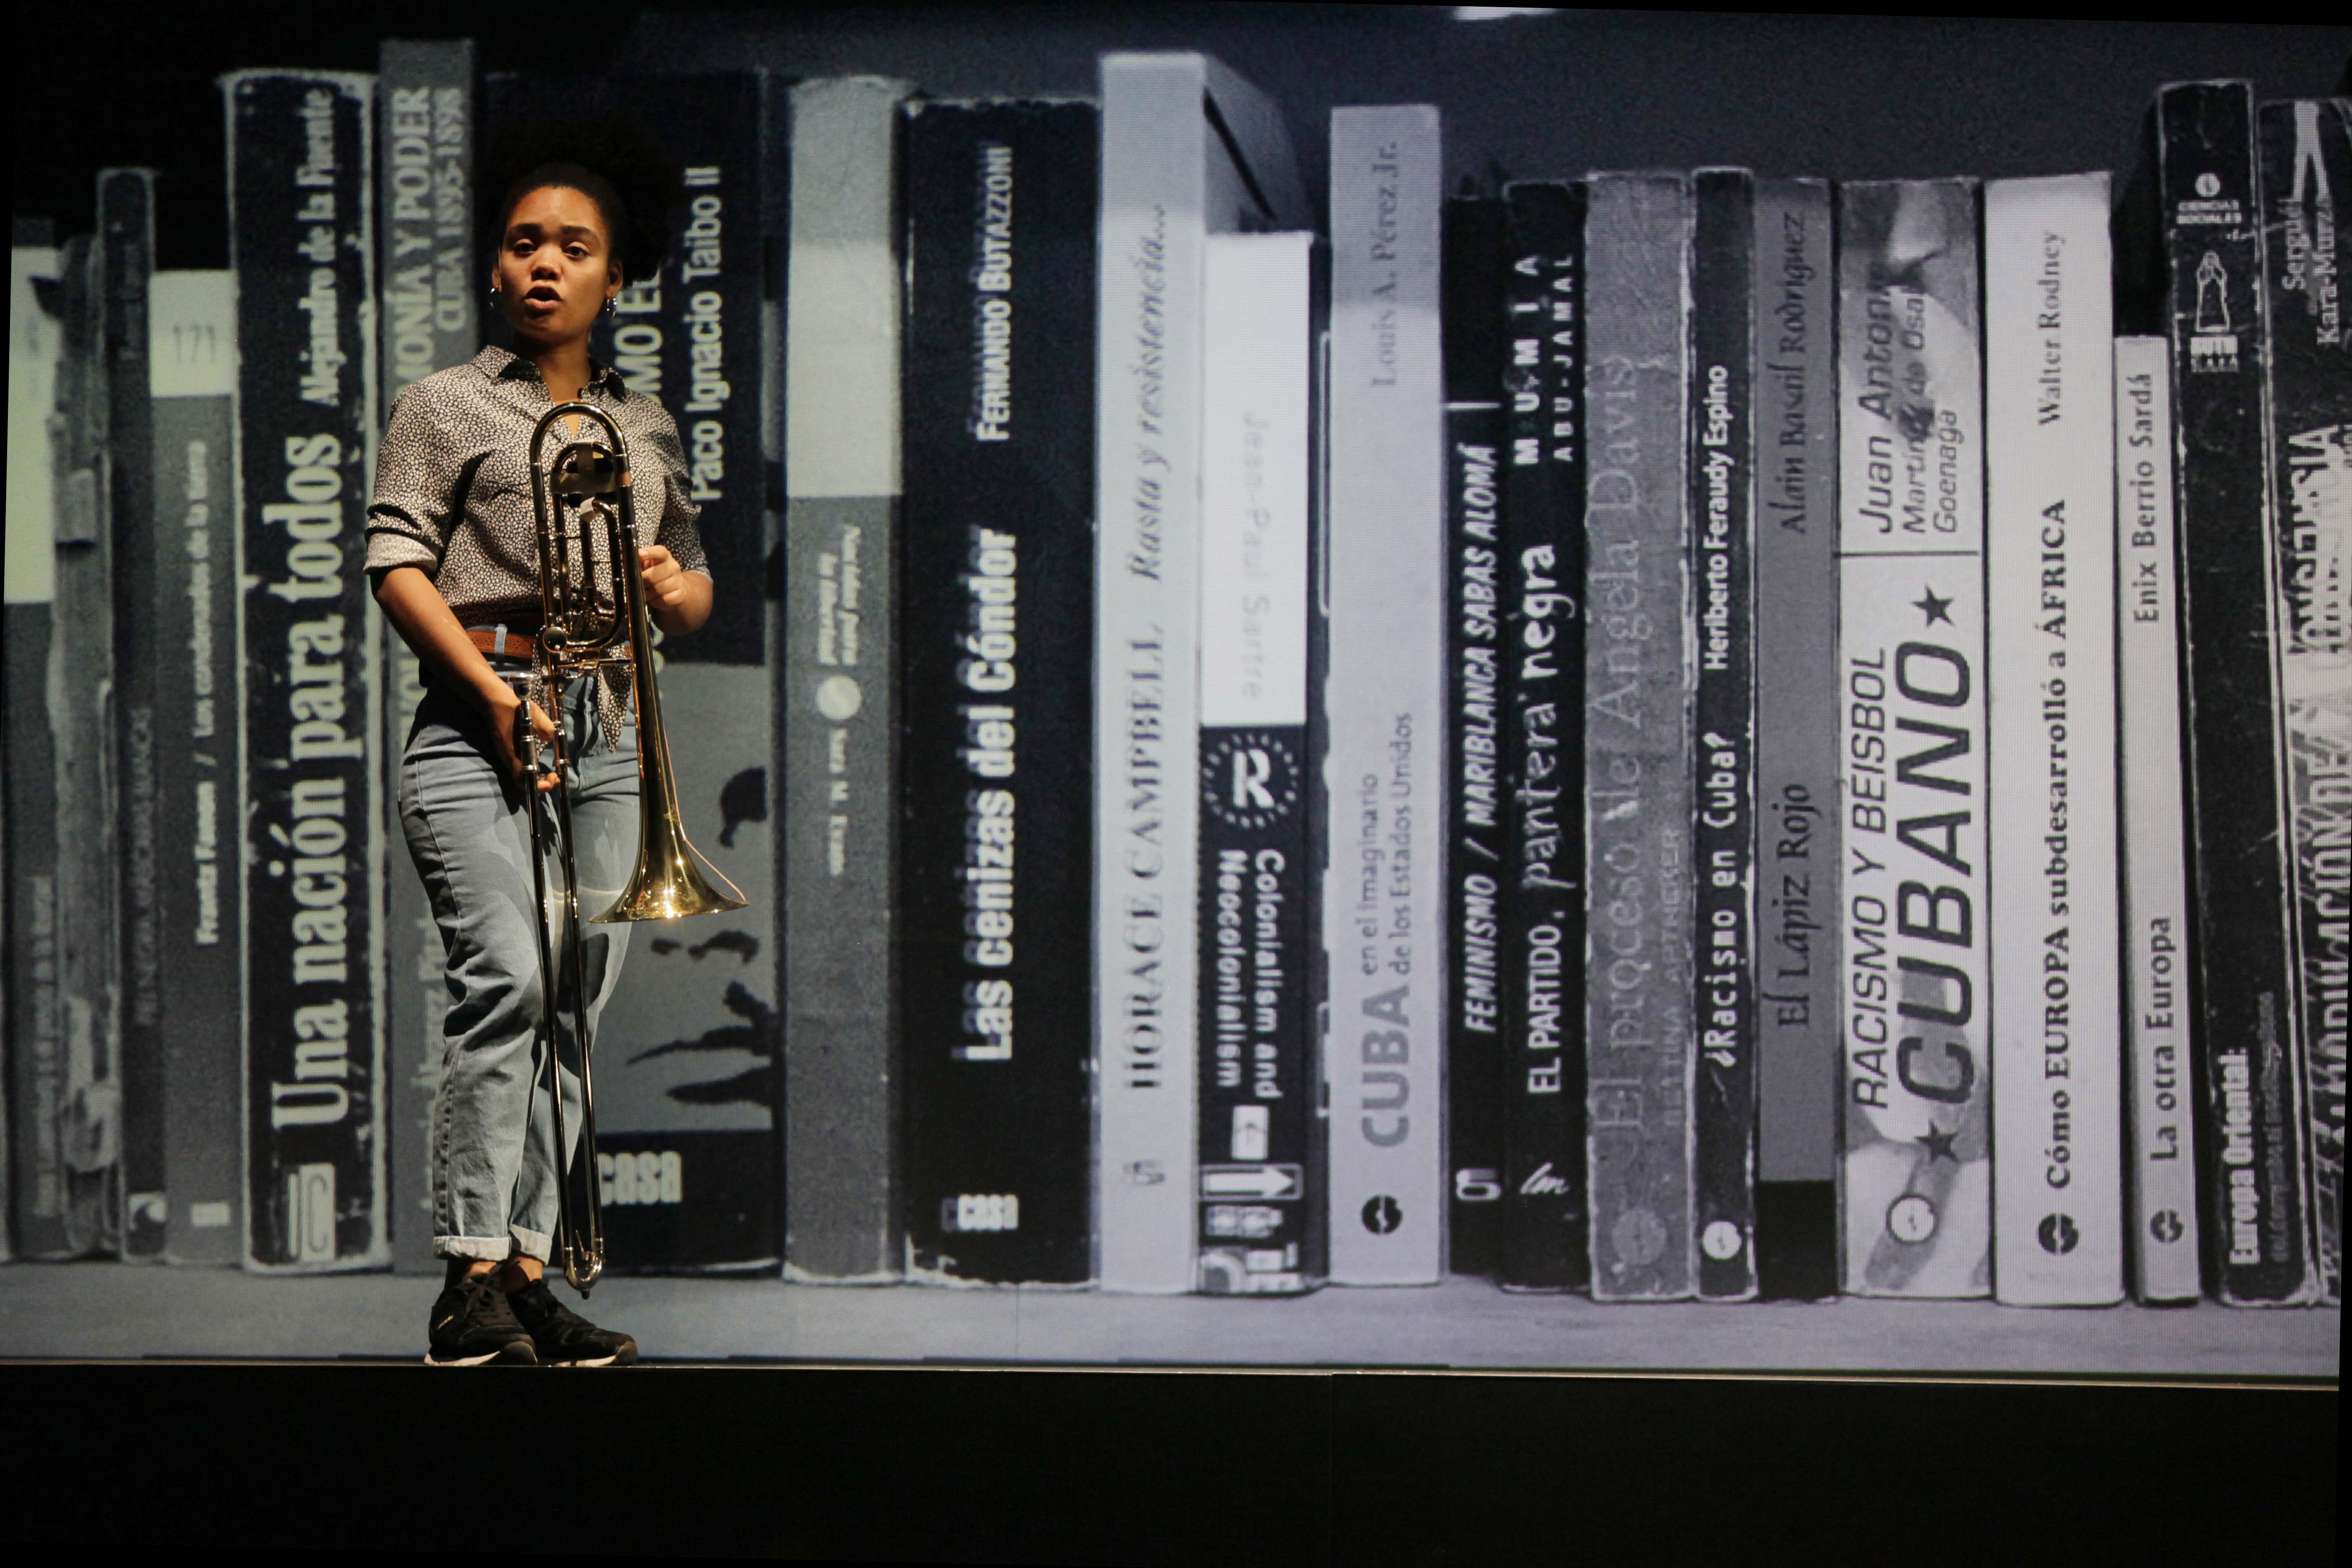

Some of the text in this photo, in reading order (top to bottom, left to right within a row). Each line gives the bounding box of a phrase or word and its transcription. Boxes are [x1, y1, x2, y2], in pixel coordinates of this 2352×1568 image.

[393, 86, 432, 220] PODER
[1368, 186, 1398, 260] Pérez
[1370, 142, 1400, 178] Jr.
[296, 89, 348, 405] Alejandro de la Fuente
[395, 227, 433, 258] Y
[435, 246, 466, 332] CUBA
[681, 196, 722, 284] Taibo
[683, 291, 731, 413] Ignacio
[1370, 309, 1397, 388] Louis
[1514, 256, 1540, 465] MUMIA
[1766, 362, 1806, 446] Basail
[2037, 230, 2066, 425] Walter Rodney
[689, 420, 725, 500] Paco
[1135, 443, 1172, 472] y
[1455, 443, 1498, 542] ALOMÁ
[1703, 365, 1735, 670] Heriberto Feraudy Espino
[1767, 458, 1806, 534] Alain
[1857, 436, 1893, 534] Juan
[1932, 409, 1965, 534] Goenaga
[2127, 374, 2159, 622] Enix Berrio Sardá
[1464, 547, 1498, 641] SABAS
[1521, 544, 1576, 680] negra
[1591, 539, 1652, 730] Angela
[262, 433, 364, 1128] Una nación para todos
[964, 528, 1017, 1062] Las cenizas del Cóndor
[1232, 749, 1275, 809] R
[1464, 647, 1498, 827] MARIBLANCA
[1516, 703, 1577, 890] pantera
[1124, 624, 1166, 1090] HORACE CAMPBELL
[1355, 773, 1384, 976] en el imaginario
[1388, 712, 1412, 976] de los Estados Unidos
[1702, 731, 1737, 1067] ¿Racismo en Cuba?
[1760, 783, 1823, 1028] El Lápiz Rojo
[1851, 847, 1888, 875] Y
[1895, 642, 1975, 1105] CUBANO
[2035, 499, 2071, 1191] Cómo EUROPA subdesarrolló a ÁFRICA
[1219, 850, 1248, 1087] Neocolonialism
[1255, 850, 1284, 1098] Colonialism and
[1465, 873, 1497, 1033] FEMINISMO
[1851, 895, 1888, 1109] RACISMO
[1361, 984, 1410, 1148] CUBA
[1527, 1057, 1562, 1094] EL
[2145, 917, 2179, 1161] La otra Europa
[597, 1151, 683, 1206] casa
